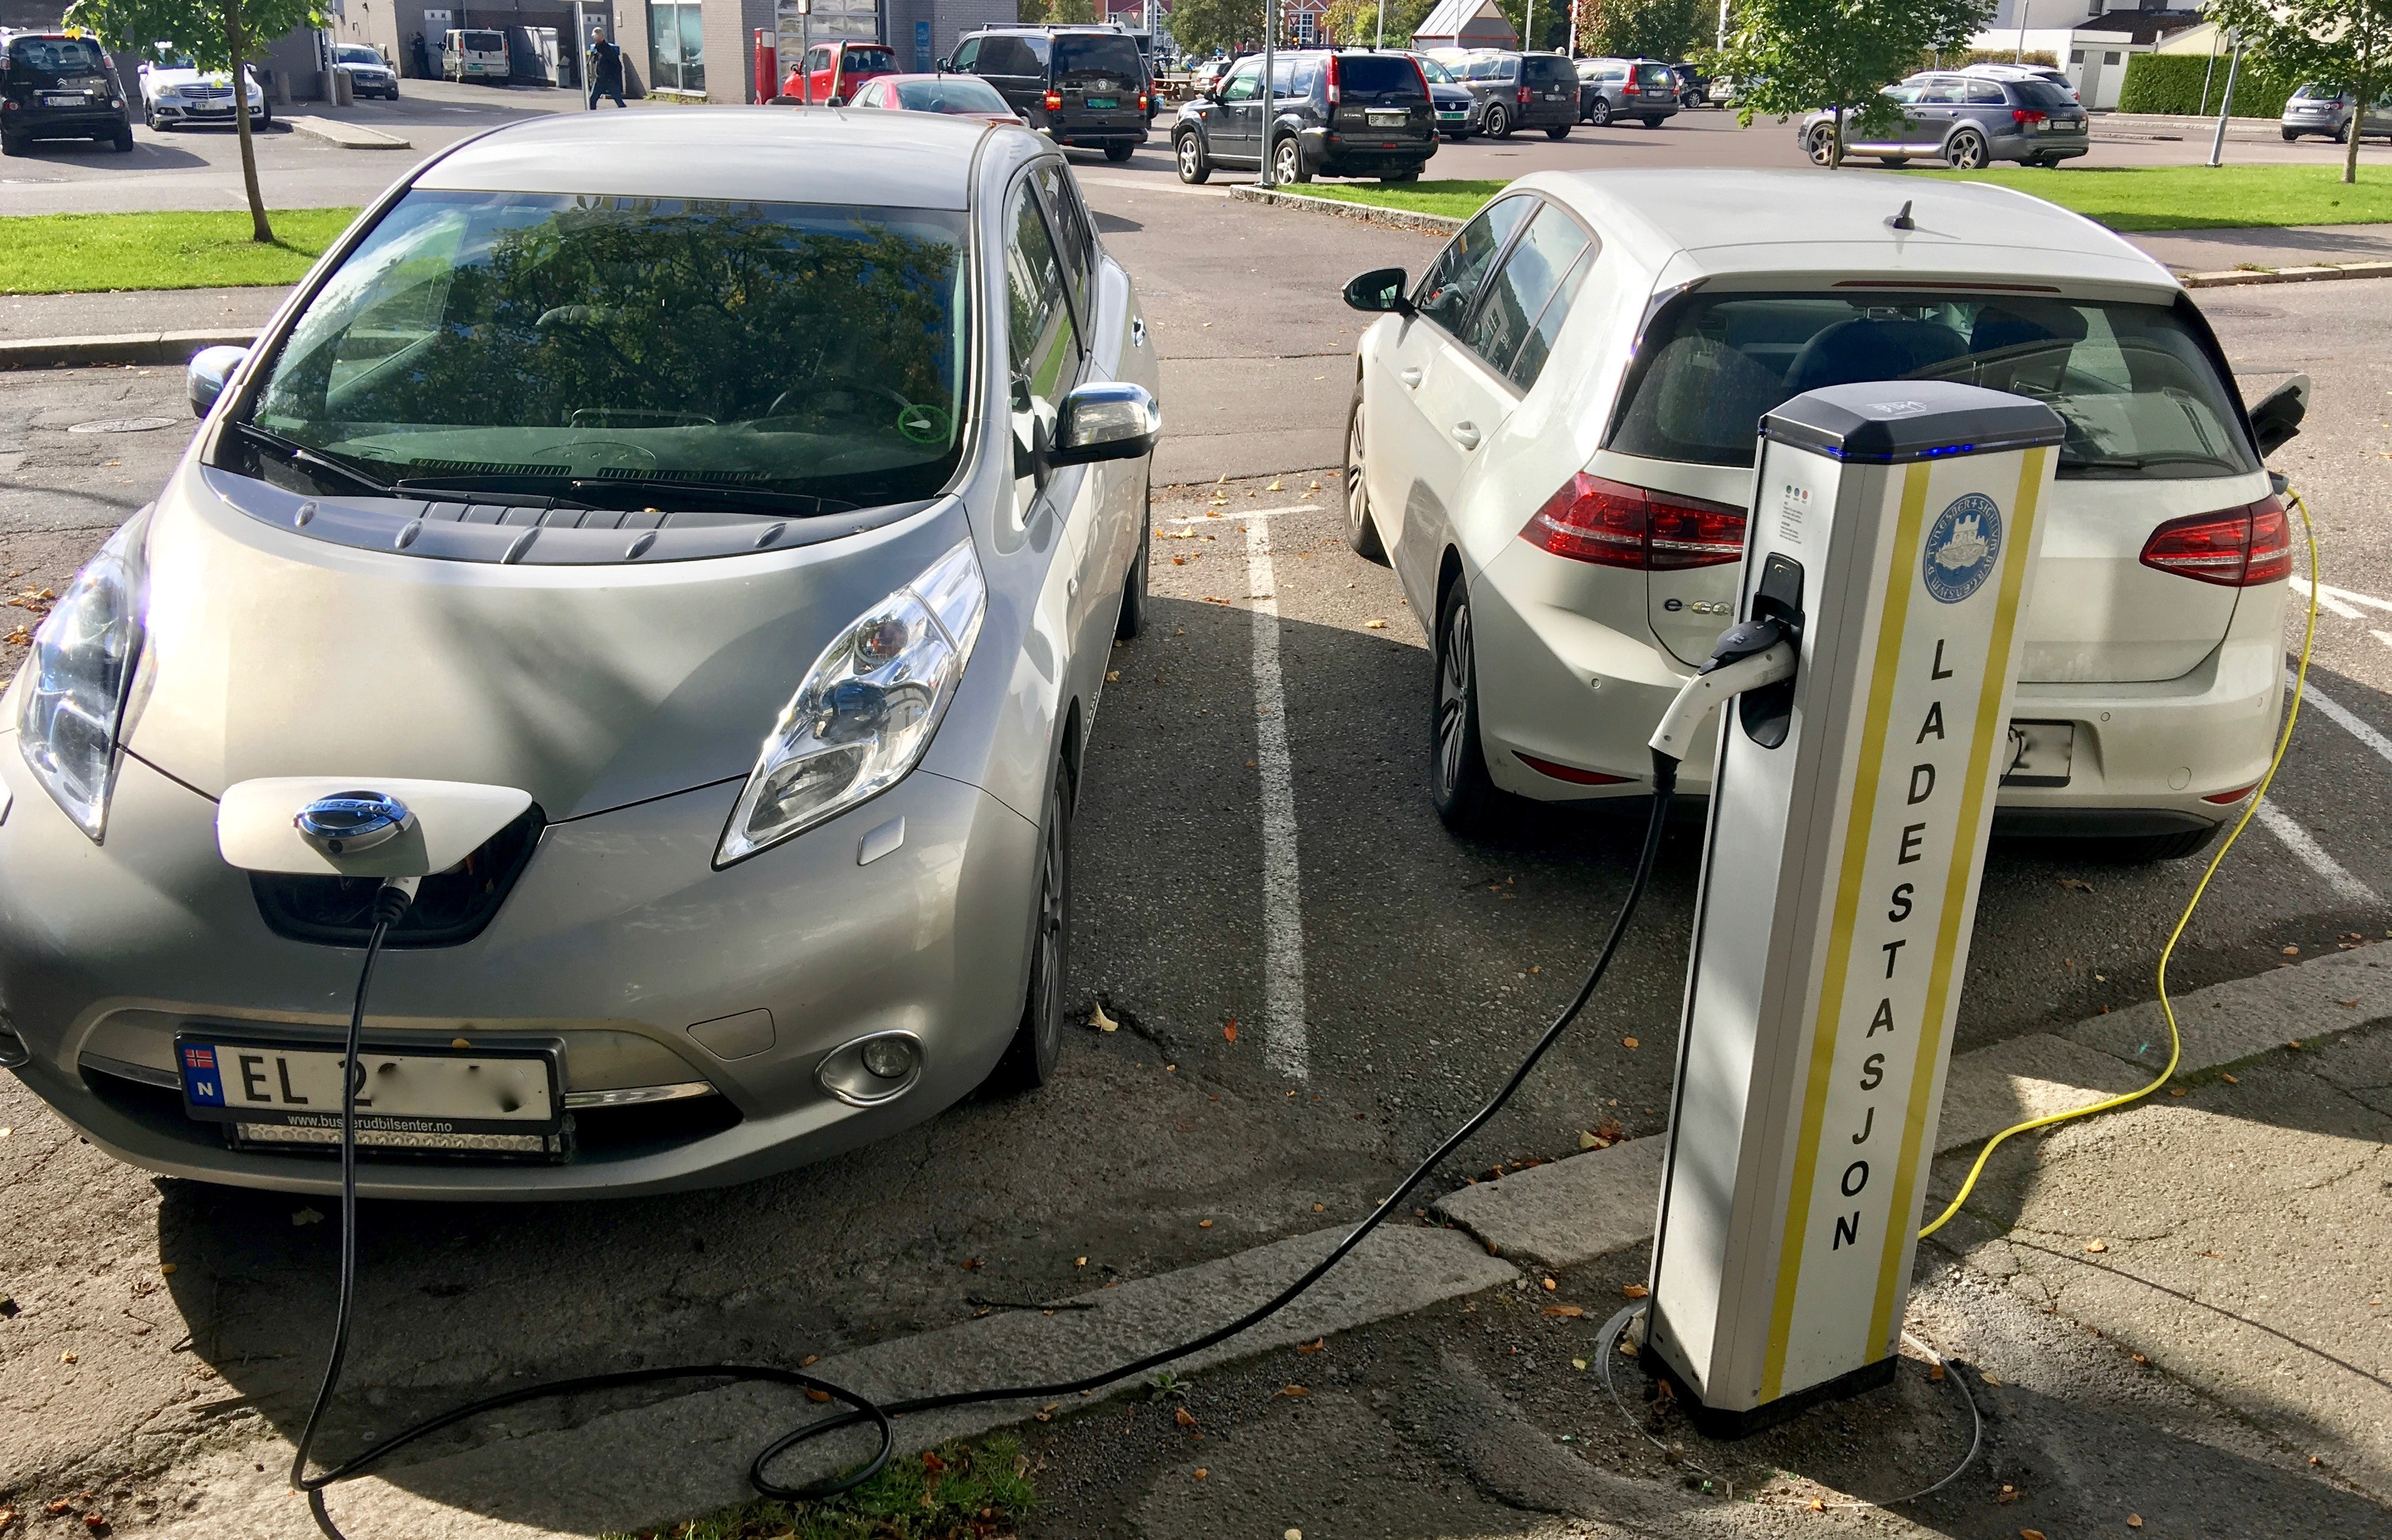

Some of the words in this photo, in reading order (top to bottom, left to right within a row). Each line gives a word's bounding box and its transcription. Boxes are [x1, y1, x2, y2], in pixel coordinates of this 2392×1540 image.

[305, 800, 392, 814] NISSAN
[1832, 638, 1953, 1251] LADESTASJON
[238, 1054, 308, 1105] EL
[197, 1082, 214, 1097] N
[287, 1115, 452, 1132] www.buserudbilsenter.no
